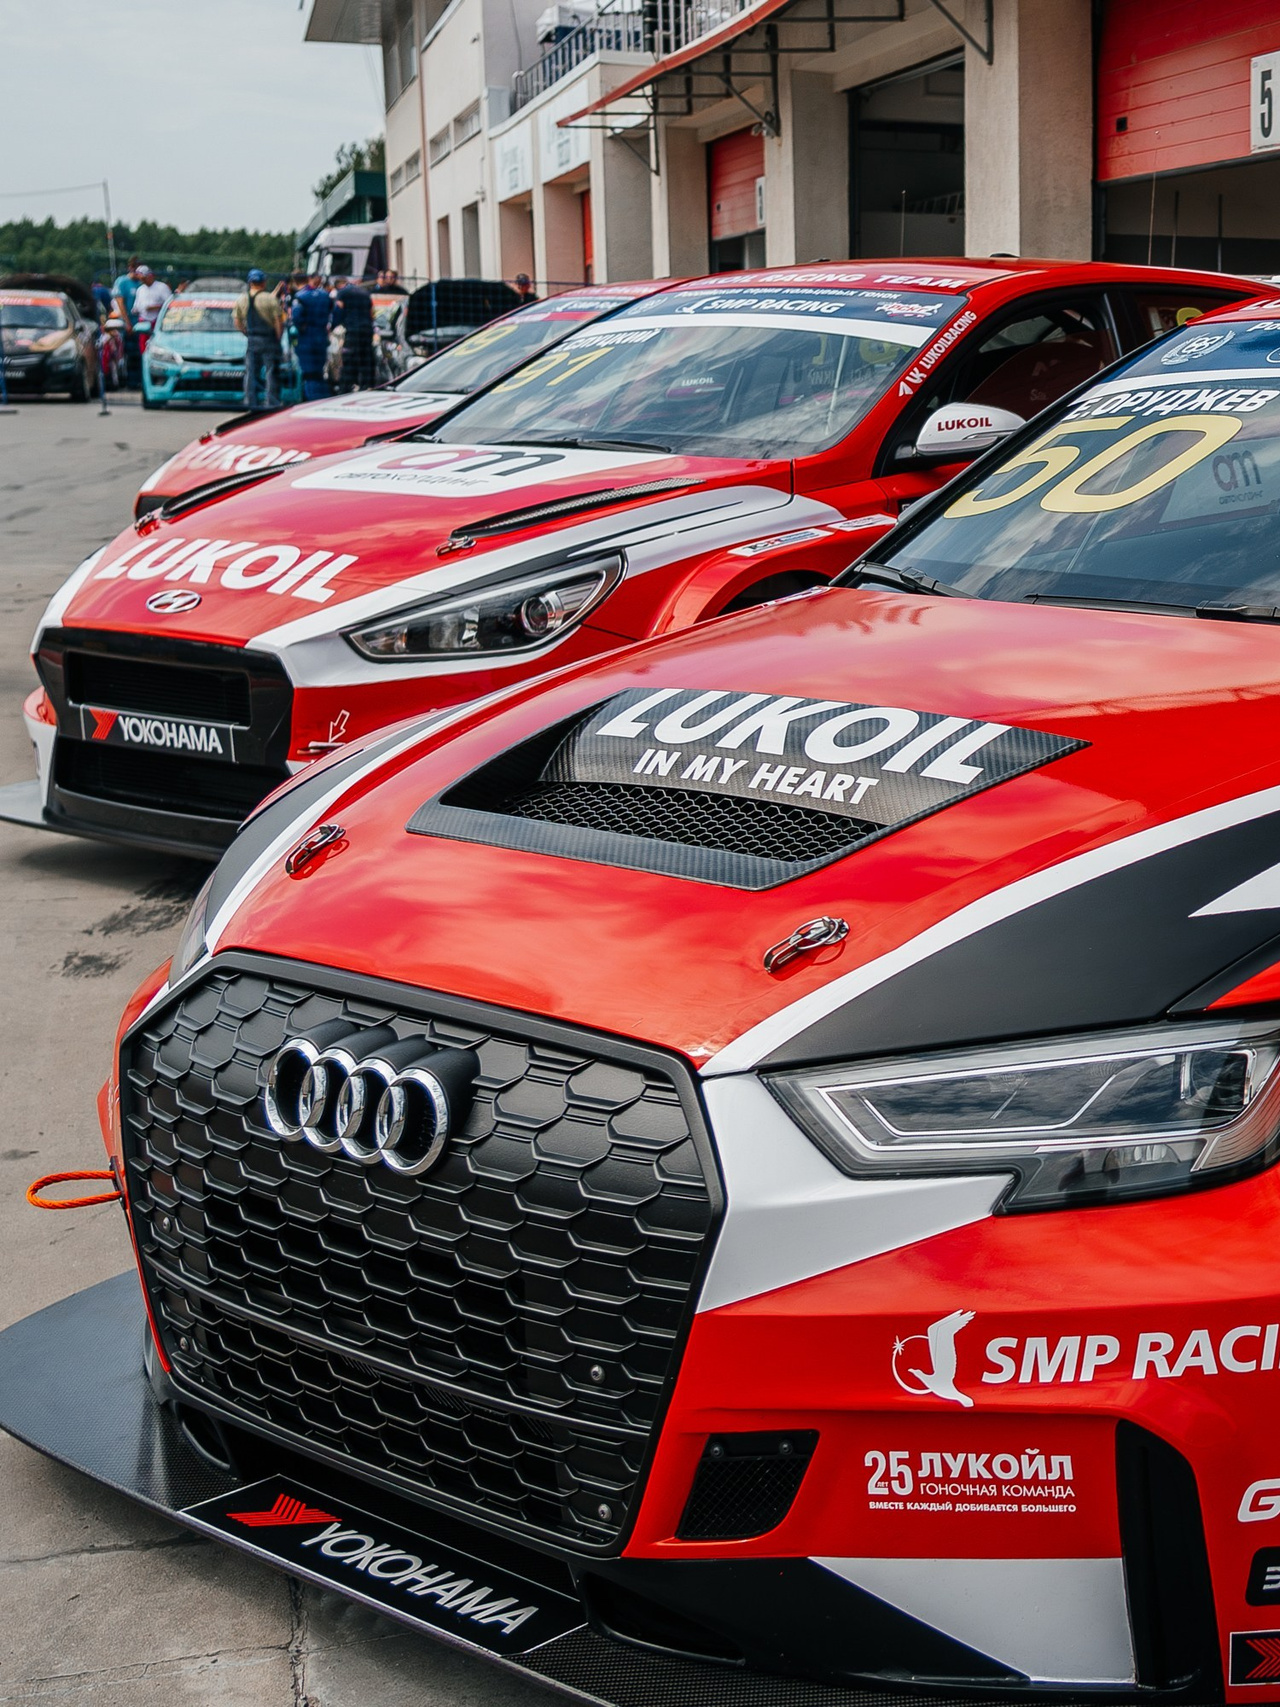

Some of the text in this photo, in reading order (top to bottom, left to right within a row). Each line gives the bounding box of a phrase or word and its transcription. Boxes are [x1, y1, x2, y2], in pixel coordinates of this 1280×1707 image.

[1260, 69, 1273, 138] 5
[760, 272, 867, 284] RACING
[872, 274, 966, 289] TEAM
[857, 290, 902, 299] гонок
[703, 298, 845, 313] SMP RACING
[918, 310, 978, 370] LUKOILRACING
[937, 416, 993, 433] LUKOIL
[1061, 389, 1280, 422] Е.ОРУДЖЕВ
[943, 414, 1243, 519] 50
[93, 538, 359, 603] LUKOIL
[118, 715, 224, 754] YOKOHAMA
[595, 688, 1012, 784] LUKOIL
[632, 748, 879, 805] IN MY HEART
[981, 1333, 1121, 1386] SMP
[864, 1448, 1074, 1496] 25 ЛУКОЙЛ
[920, 1483, 1076, 1499] ГОНОЧНАЯ КОМАНДА
[868, 1501, 1077, 1513] ВМЕСТЕ КАЖДЫЙ ДОБИВАЕТСЯ БОЛЬШЕГО
[301, 1522, 540, 1635] YOKOHAMA
